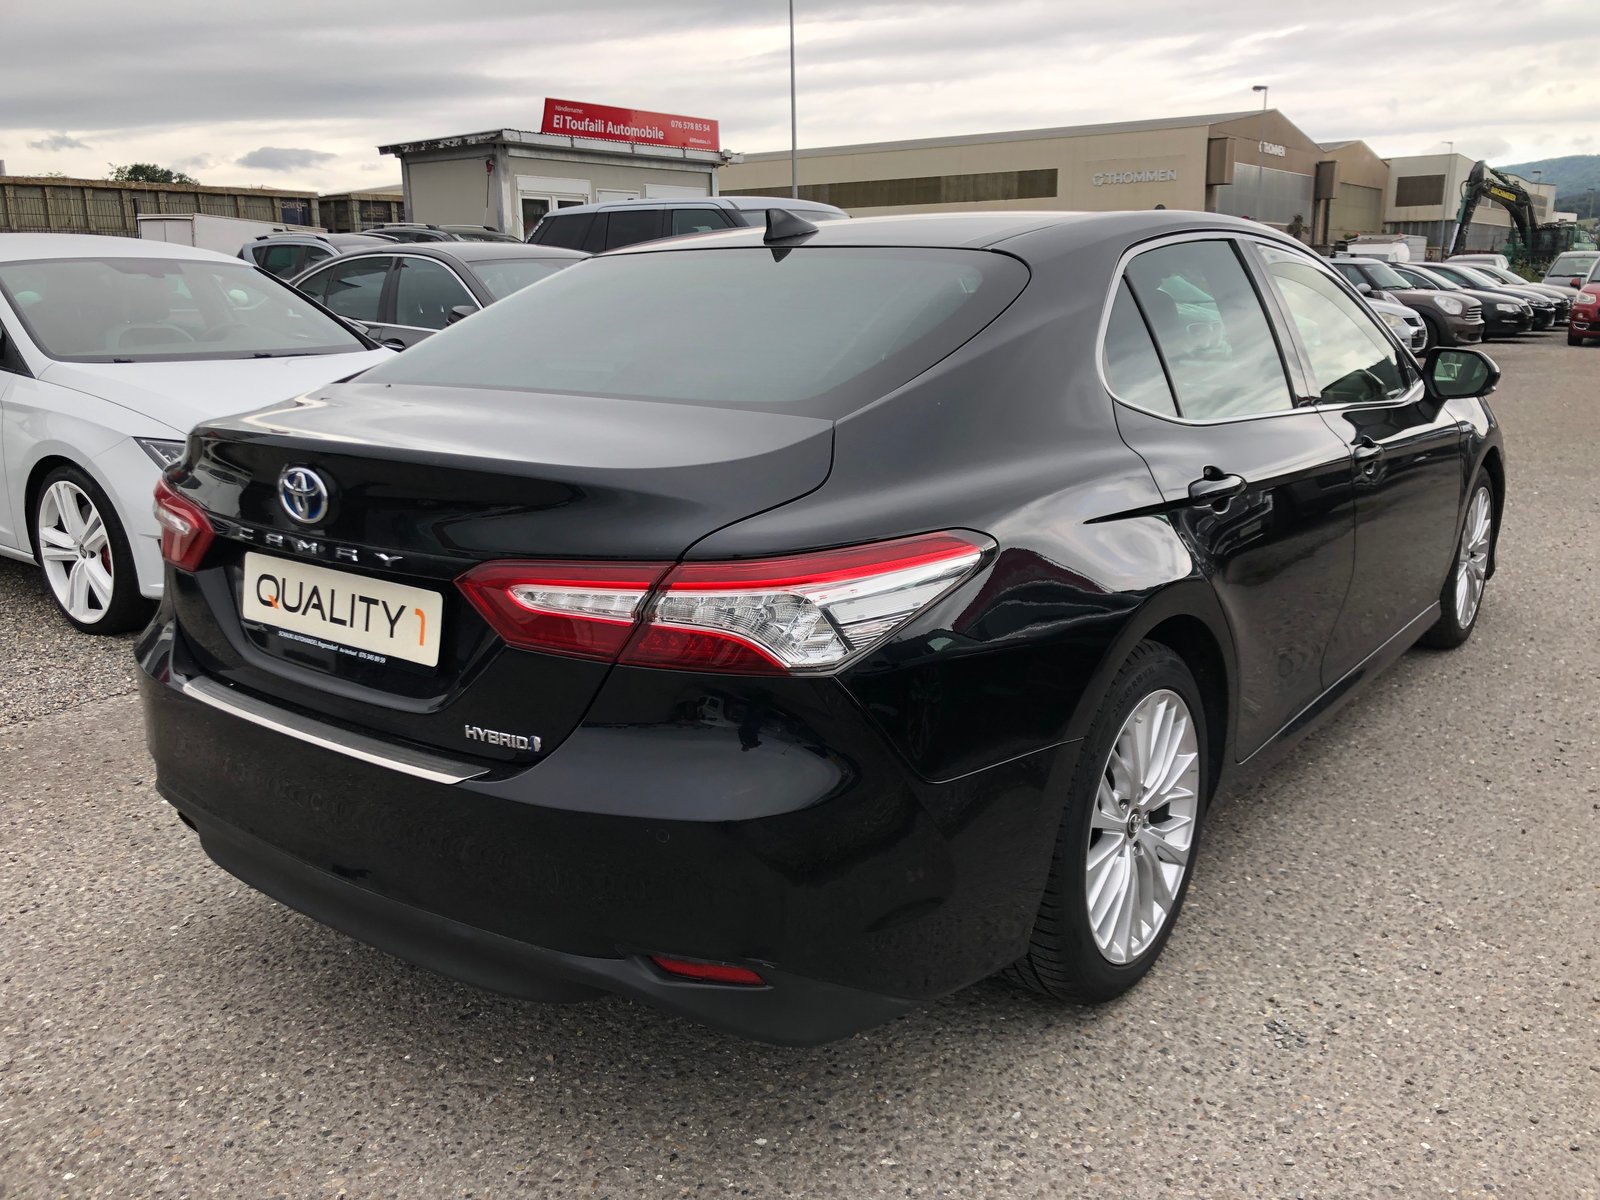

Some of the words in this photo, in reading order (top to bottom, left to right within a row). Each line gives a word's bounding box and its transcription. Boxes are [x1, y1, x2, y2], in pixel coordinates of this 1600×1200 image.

[553, 114, 563, 129] El
[565, 116, 605, 133] Toufaili
[606, 121, 664, 140] Automobile
[670, 120, 682, 129] 076
[683, 121, 694, 130] 578
[695, 123, 702, 131] 85
[703, 124, 710, 132] 54
[1107, 169, 1177, 185] THOMMEN
[239, 526, 404, 567] CAMRY
[465, 724, 528, 750] HYBRID
